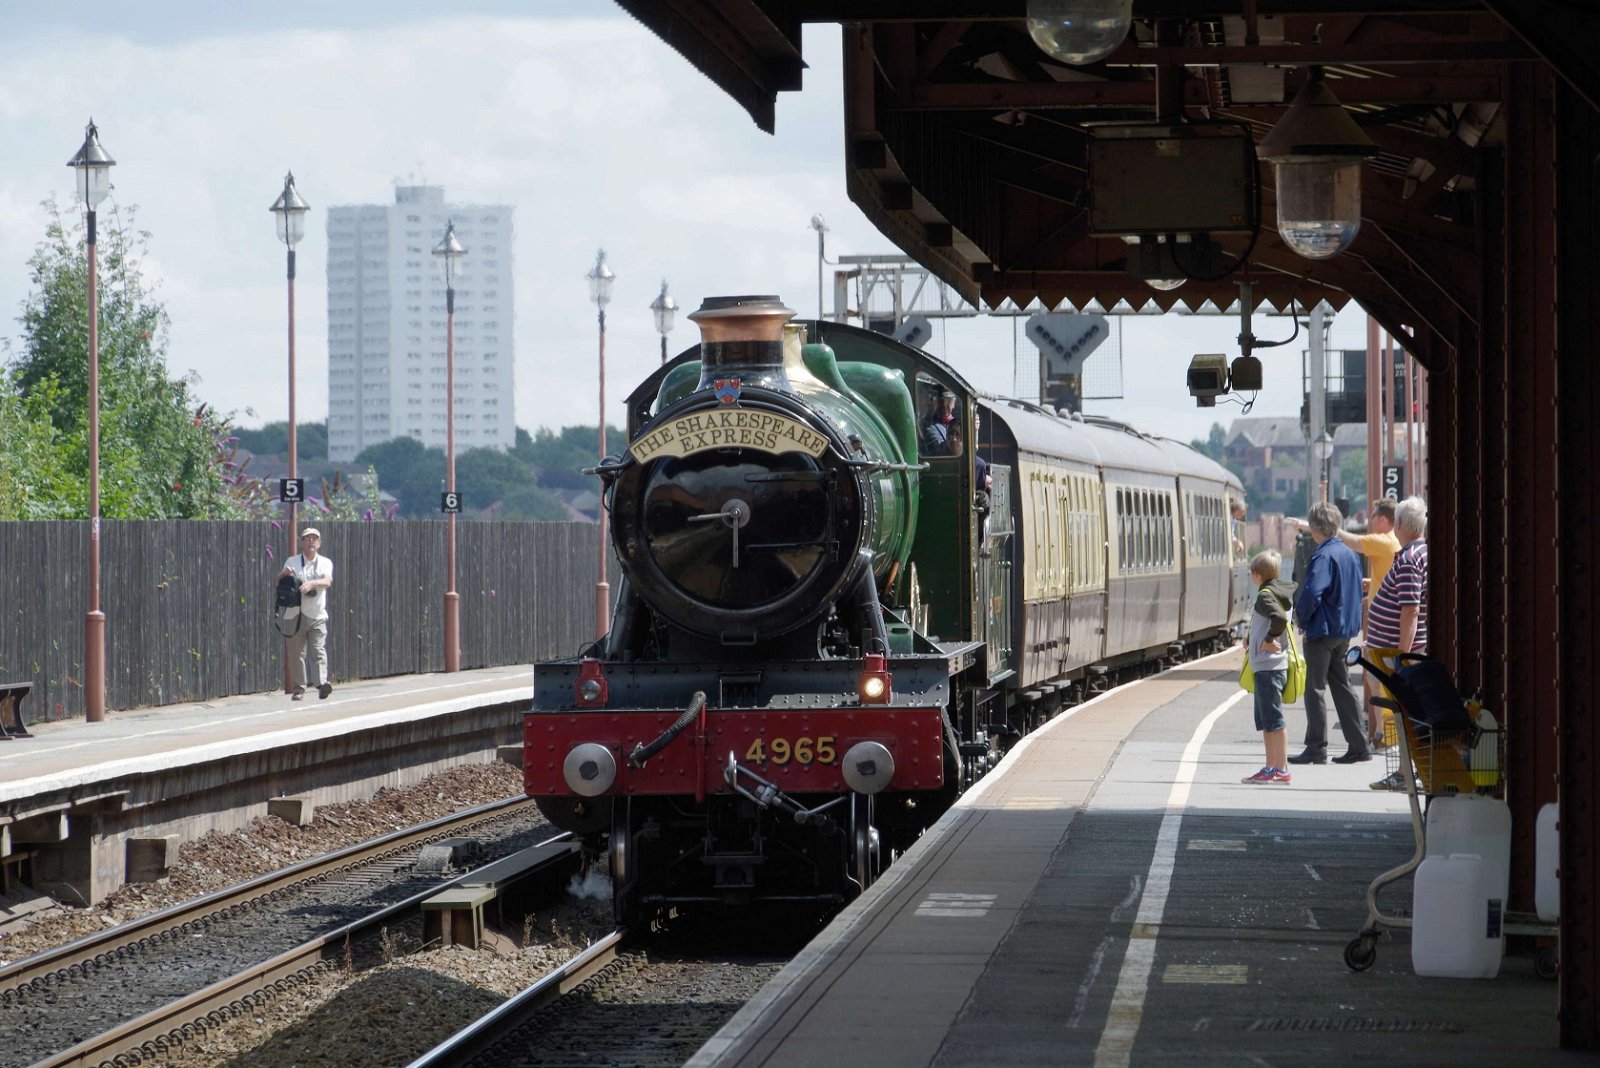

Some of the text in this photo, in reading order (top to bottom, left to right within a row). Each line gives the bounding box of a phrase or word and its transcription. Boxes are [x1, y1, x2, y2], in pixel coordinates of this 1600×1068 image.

[634, 412, 825, 459] THE SHAKESPEARE
[679, 428, 778, 453] EXPRESS
[1386, 468, 1398, 484] 5
[286, 480, 298, 497] 5
[1385, 487, 1398, 502] 6
[446, 493, 457, 508] 6
[745, 736, 836, 765] 4965
